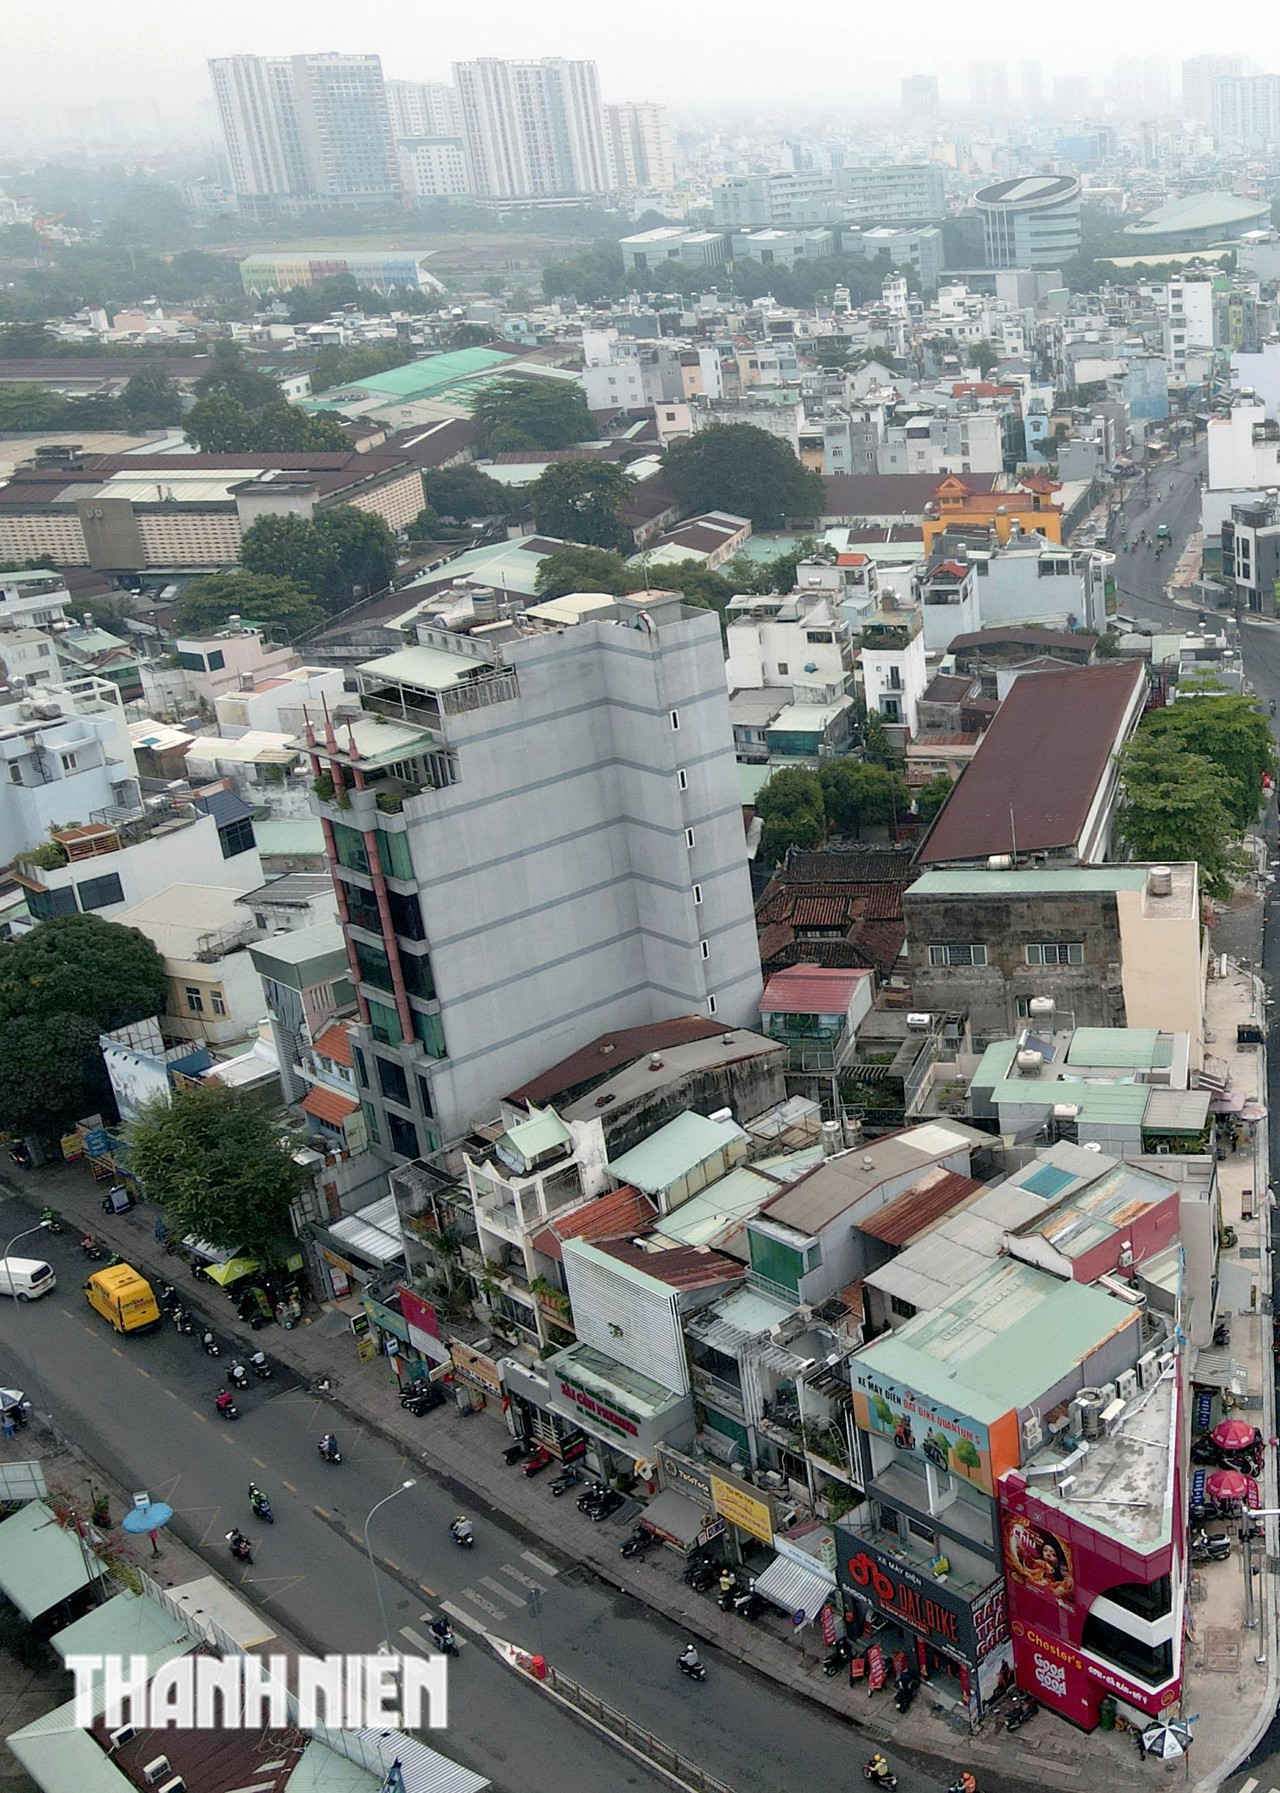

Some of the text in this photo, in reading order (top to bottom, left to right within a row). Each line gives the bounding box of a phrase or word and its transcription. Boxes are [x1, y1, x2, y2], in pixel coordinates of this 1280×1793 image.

[974, 1590, 1006, 1628] BÁN
[977, 1623, 1007, 1657] GÓP
[1027, 1630, 1082, 1670] Chester's
[1034, 1653, 1065, 1680] Good
[1035, 1667, 1067, 1696] Good
